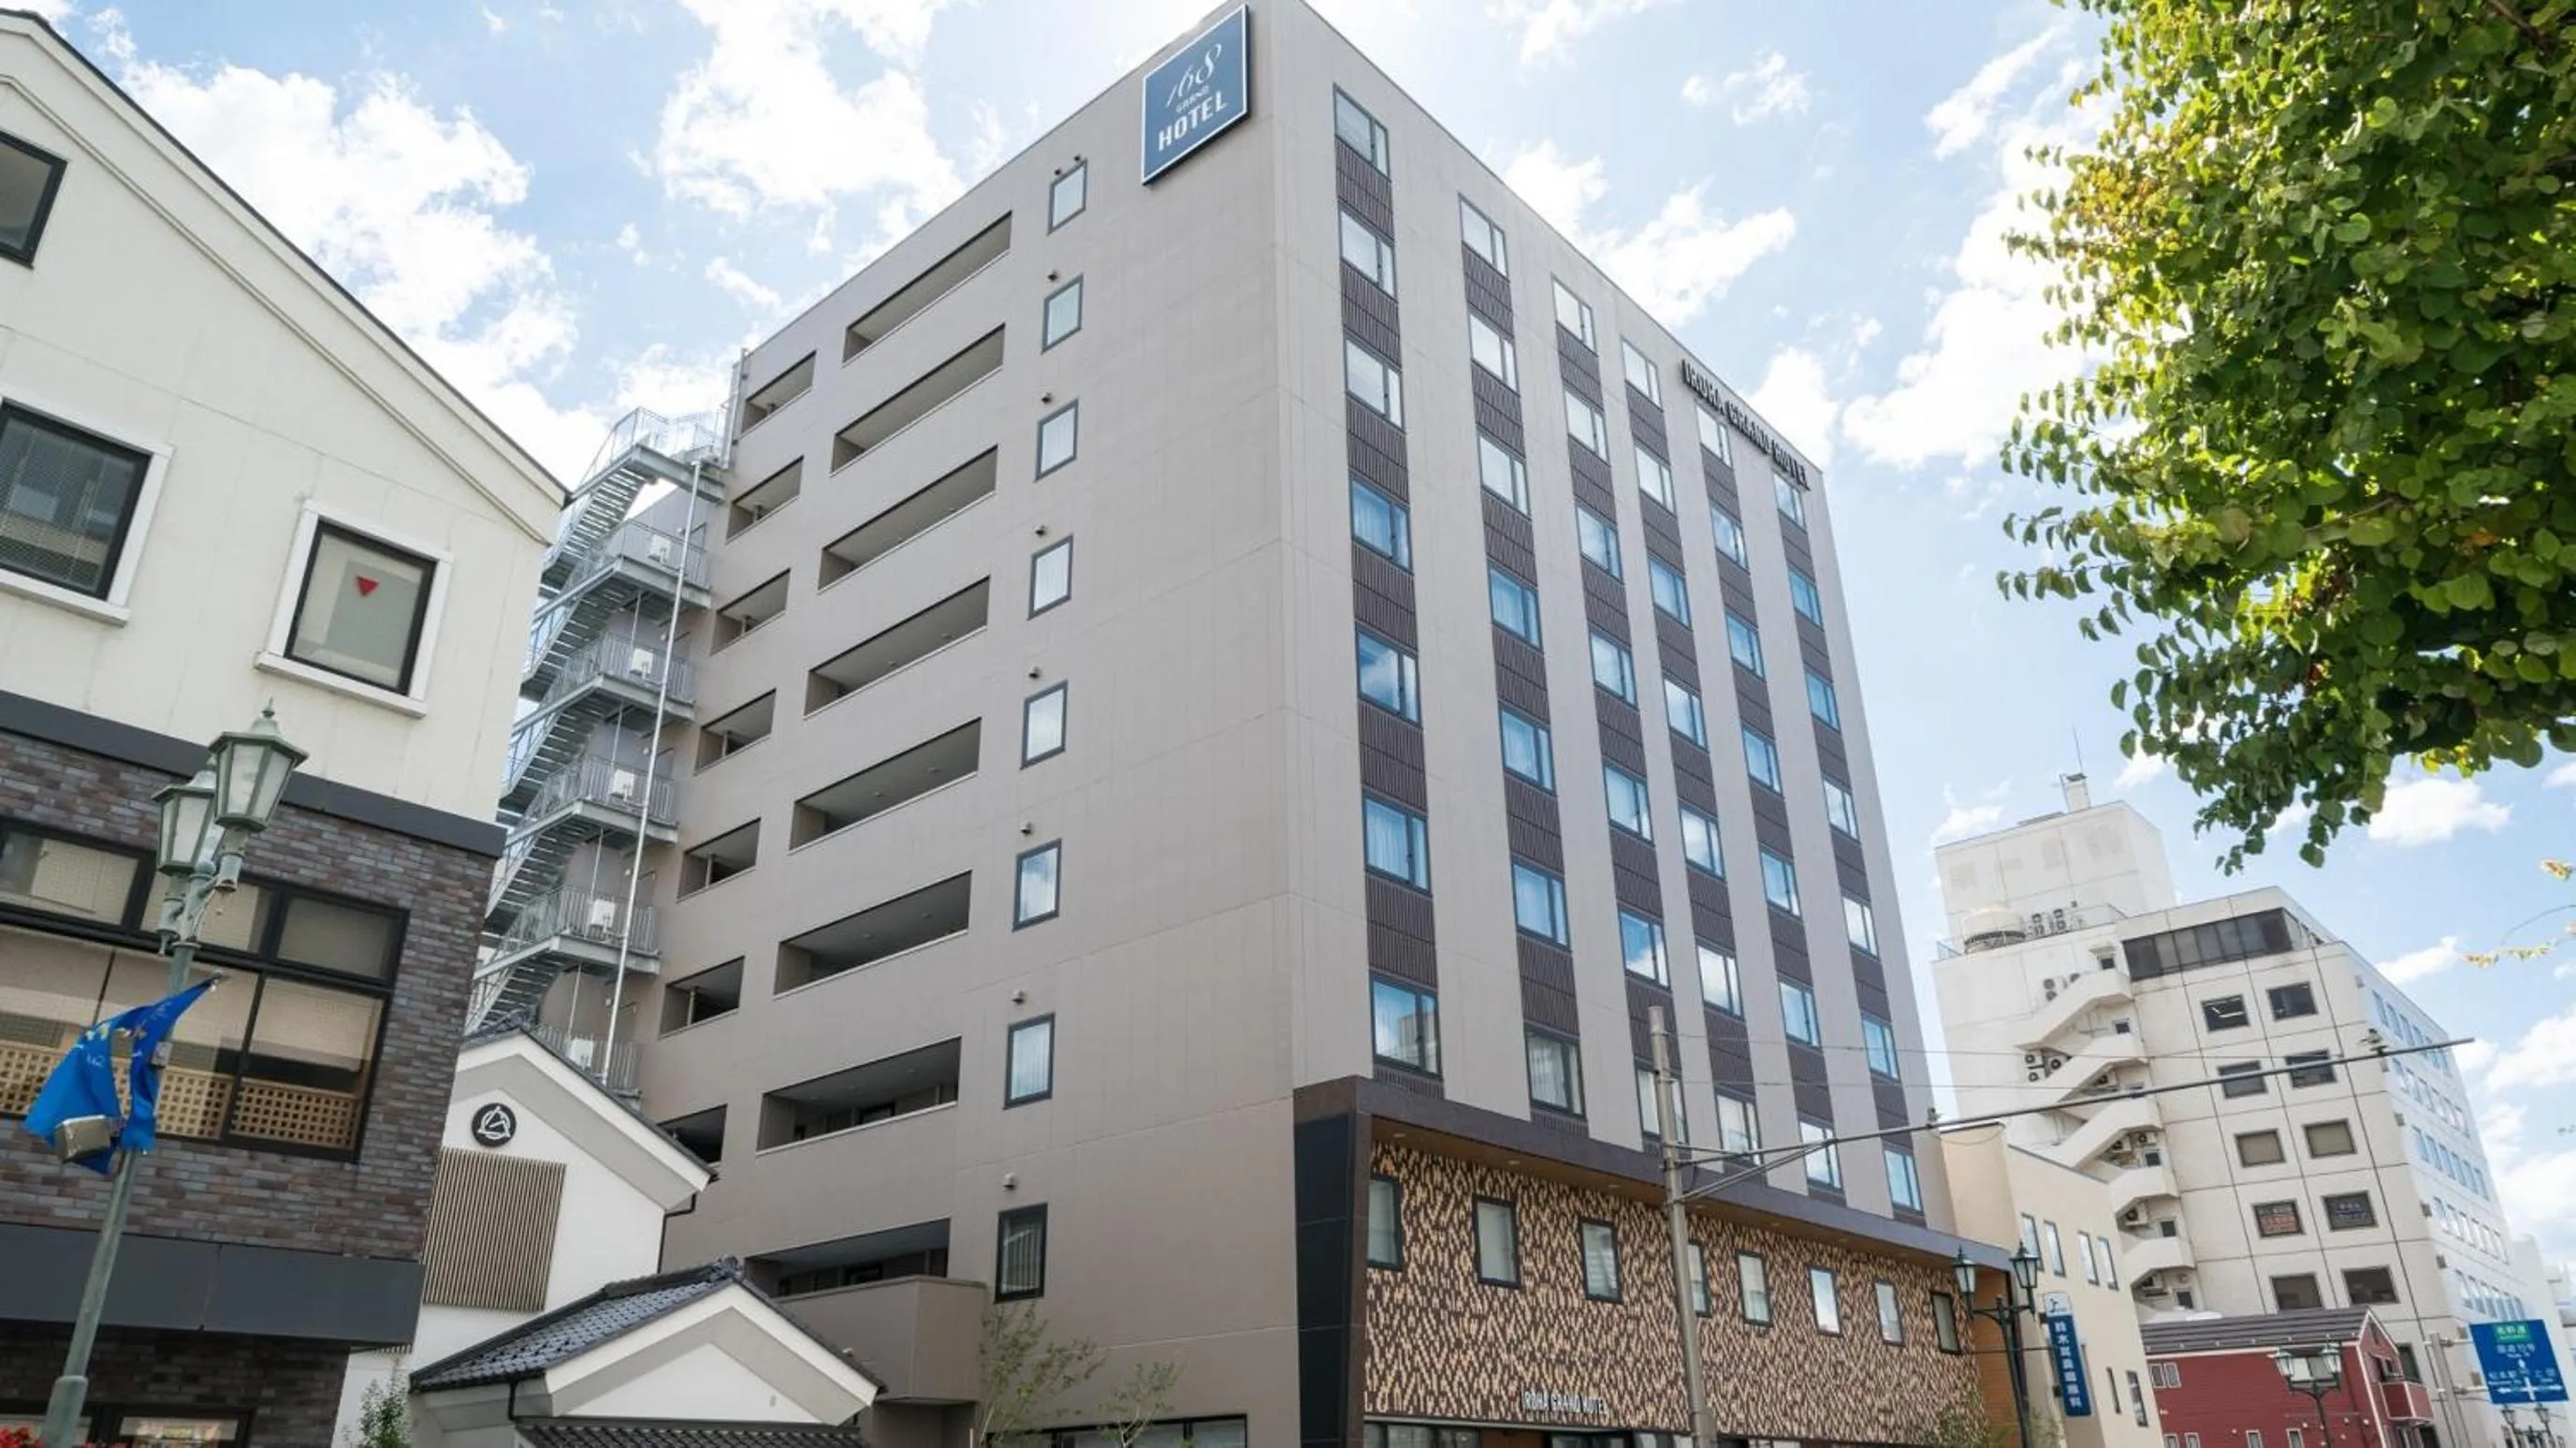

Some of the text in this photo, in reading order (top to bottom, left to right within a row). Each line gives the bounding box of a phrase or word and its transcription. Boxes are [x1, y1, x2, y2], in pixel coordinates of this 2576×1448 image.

[1175, 85, 1210, 113] GRAND
[1157, 90, 1229, 152] HOTEL
[1551, 1391, 1581, 1413] GRAND
